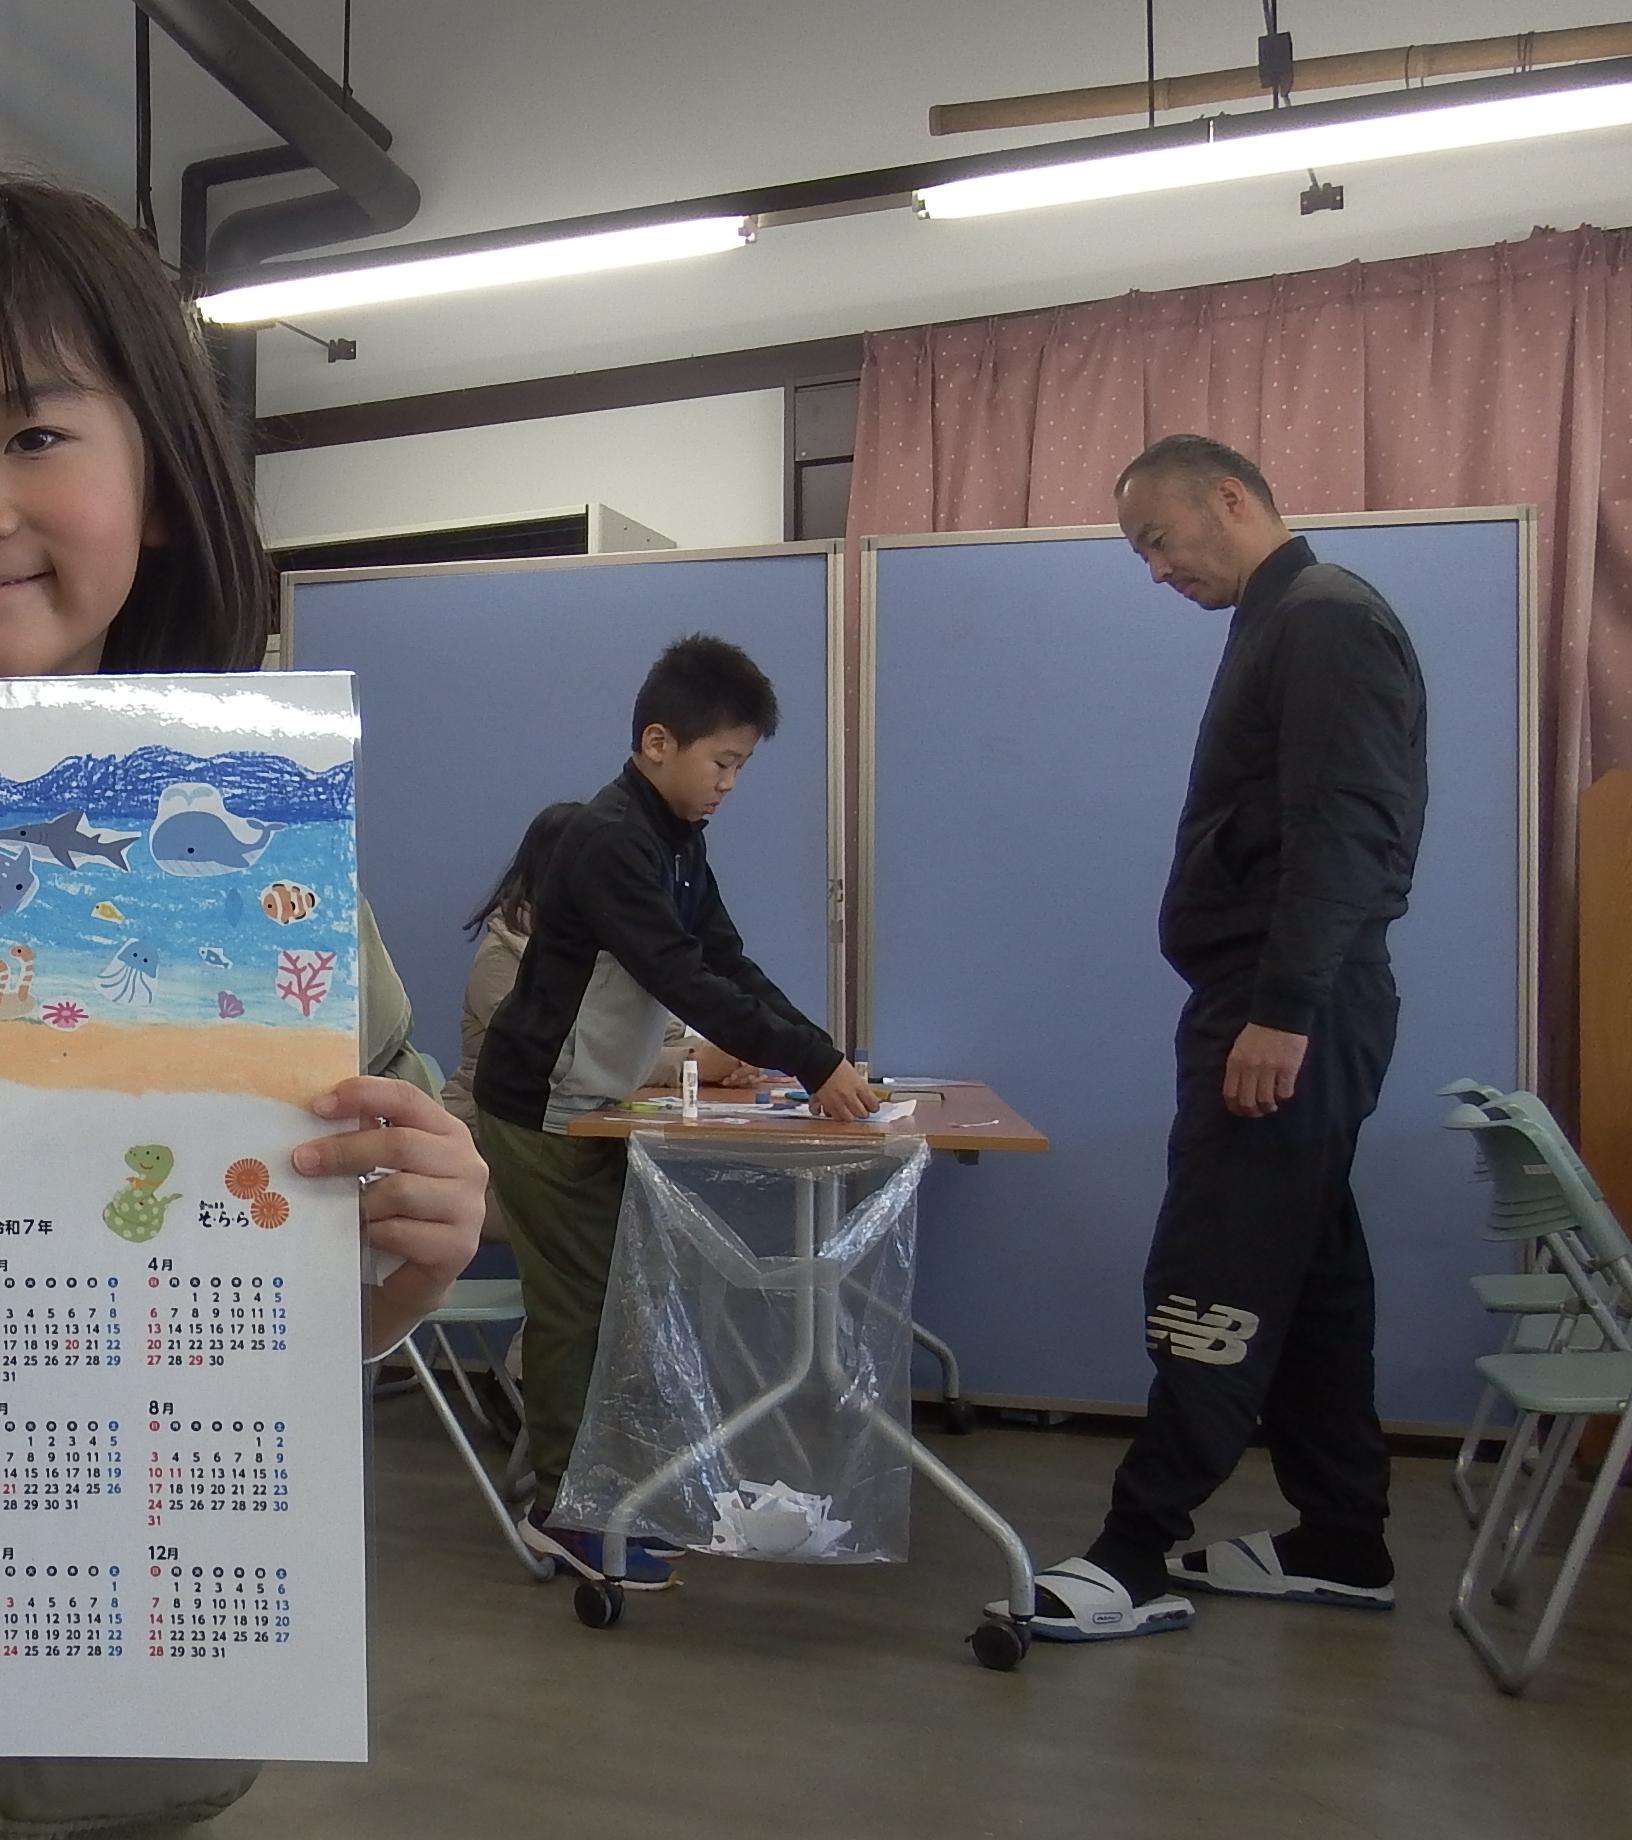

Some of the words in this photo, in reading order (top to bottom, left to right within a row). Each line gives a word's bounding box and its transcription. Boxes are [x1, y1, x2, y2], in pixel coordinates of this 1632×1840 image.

[148, 1257, 172, 1271] 4月
[109, 1293, 116, 1302] 1
[149, 1308, 158, 1318] 6
[170, 1308, 179, 1318] 7
[191, 1308, 200, 1318] 8
[212, 1308, 220, 1318] 9
[231, 1308, 244, 1318] 10
[252, 1308, 263, 1318] 11
[272, 1308, 285, 1318] 12
[3, 1356, 17, 1366] 24
[24, 1356, 38, 1366] 25
[45, 1356, 58, 1366] 26
[65, 1355, 79, 1365] 27
[86, 1356, 100, 1365] 28
[107, 1355, 120, 1366] 29
[3, 1371, 15, 1382] 31
[149, 1400, 173, 1415] 8月
[256, 1437, 262, 1447] 1
[276, 1437, 284, 1447] 2
[149, 1468, 162, 1478] 10
[170, 1468, 181, 1478] 11
[191, 1468, 203, 1478] 12
[212, 1468, 225, 1478] 13
[232, 1469, 245, 1478] 14
[253, 1469, 266, 1479] 15
[274, 1469, 288, 1479] 16
[3, 1484, 15, 1494] 21
[24, 1484, 38, 1494] 22
[45, 1484, 59, 1494] 23
[66, 1484, 79, 1494] 24
[86, 1483, 100, 1494] 25
[107, 1483, 121, 1494] 26
[148, 1515, 160, 1526] 31
[149, 1546, 178, 1560] 12月
[111, 1581, 117, 1591] 1
[4, 1614, 18, 1624] 10
[25, 1614, 37, 1624] 11
[46, 1613, 59, 1624] 12
[67, 1613, 80, 1624] 13
[88, 1613, 101, 1624] 14
[109, 1613, 122, 1624] 15
[149, 1630, 161, 1640] 21
[170, 1630, 184, 1641] 22
[191, 1630, 205, 1641] 23
[212, 1631, 226, 1641] 24
[233, 1631, 247, 1642] 25
[254, 1632, 268, 1642] 26
[275, 1632, 289, 1642] 27
[149, 1646, 164, 1656] 28
[171, 1646, 185, 1657] 29
[191, 1647, 206, 1657] 30
[212, 1647, 225, 1658] 31
